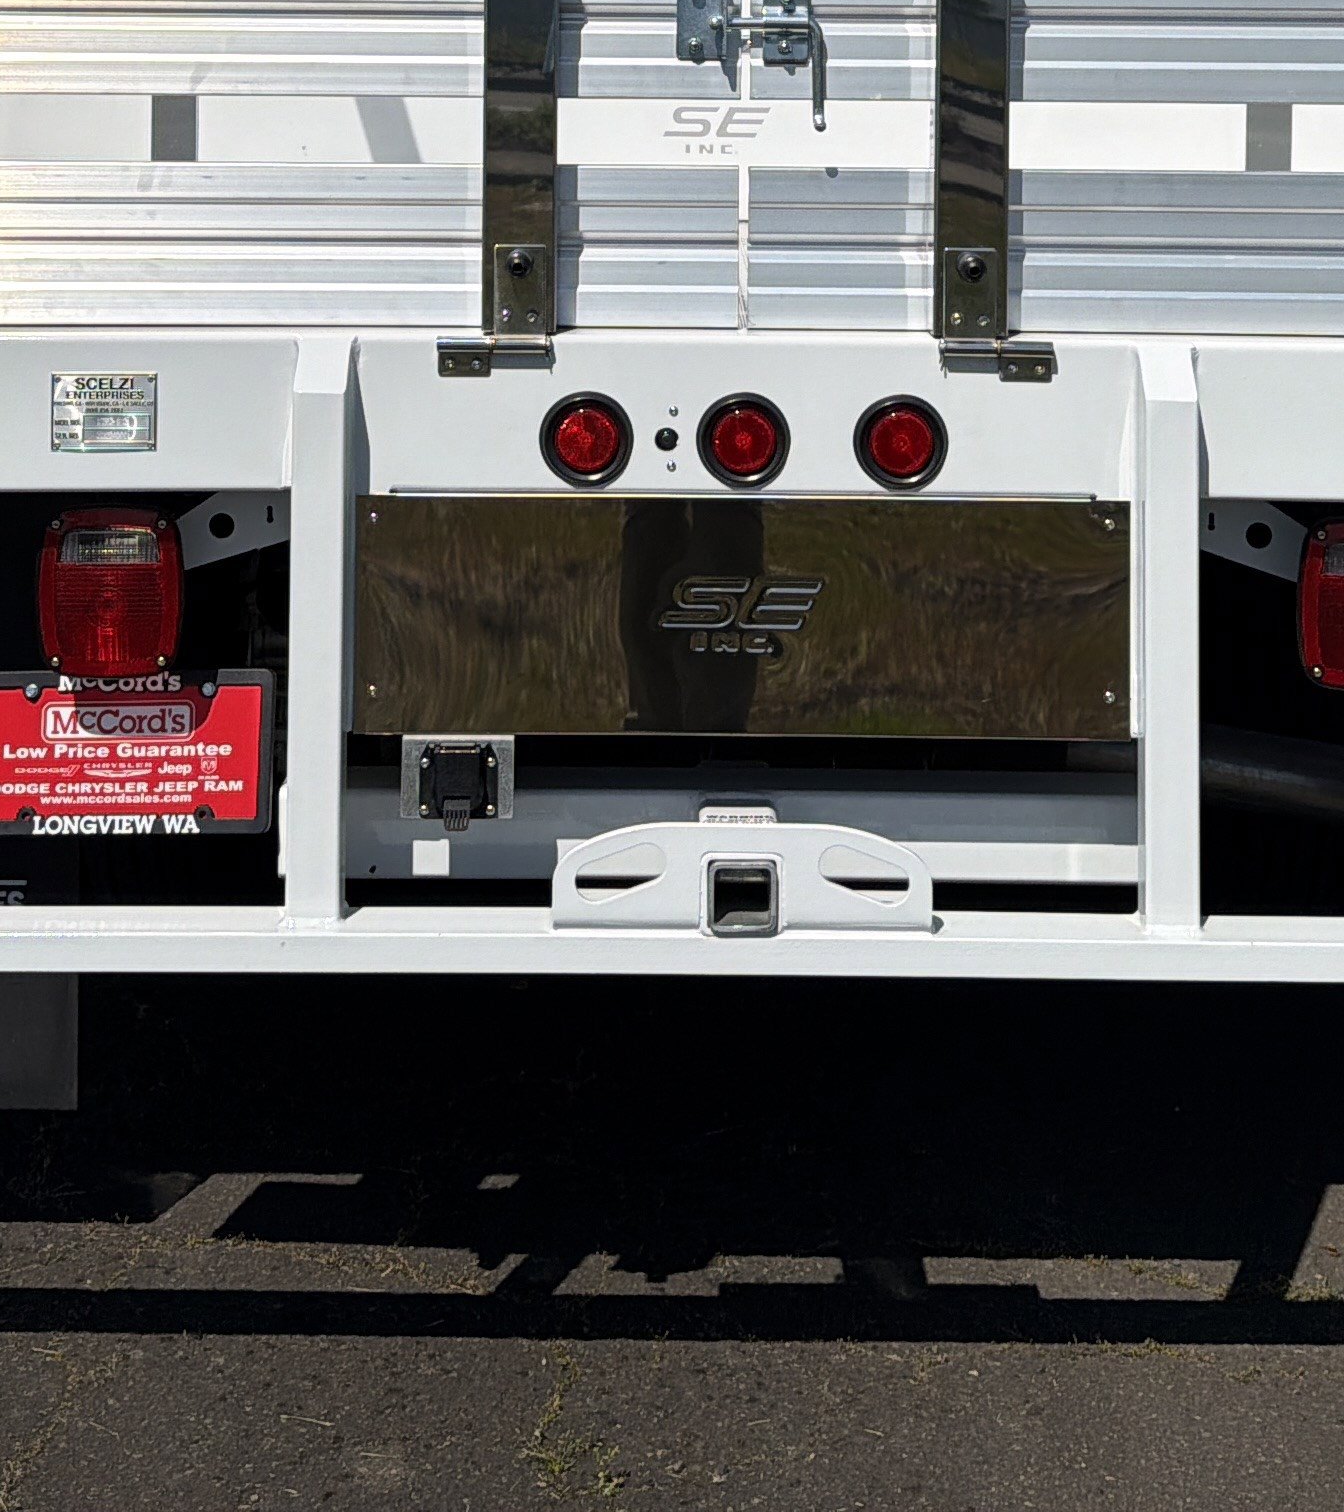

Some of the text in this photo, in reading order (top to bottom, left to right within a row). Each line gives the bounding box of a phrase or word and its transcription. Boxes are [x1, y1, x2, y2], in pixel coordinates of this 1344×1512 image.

[663, 106, 772, 139] SE
[75, 377, 135, 390] SCELZI
[65, 391, 145, 400] ENTERPRISES
[657, 575, 826, 631] SE
[689, 631, 775, 654] INC.
[50, 708, 186, 736] McCord's
[2, 742, 234, 759] Low Price Guarantee
[83, 762, 154, 770] CHRYSLER
[157, 761, 193, 776] Jeep
[55, 781, 149, 794] CHRYSLER
[153, 780, 199, 793] JEEP
[203, 779, 244, 792] RAM
[40, 792, 193, 805] www.mccordsales.com
[32, 814, 201, 836] LONGVIEW WA
